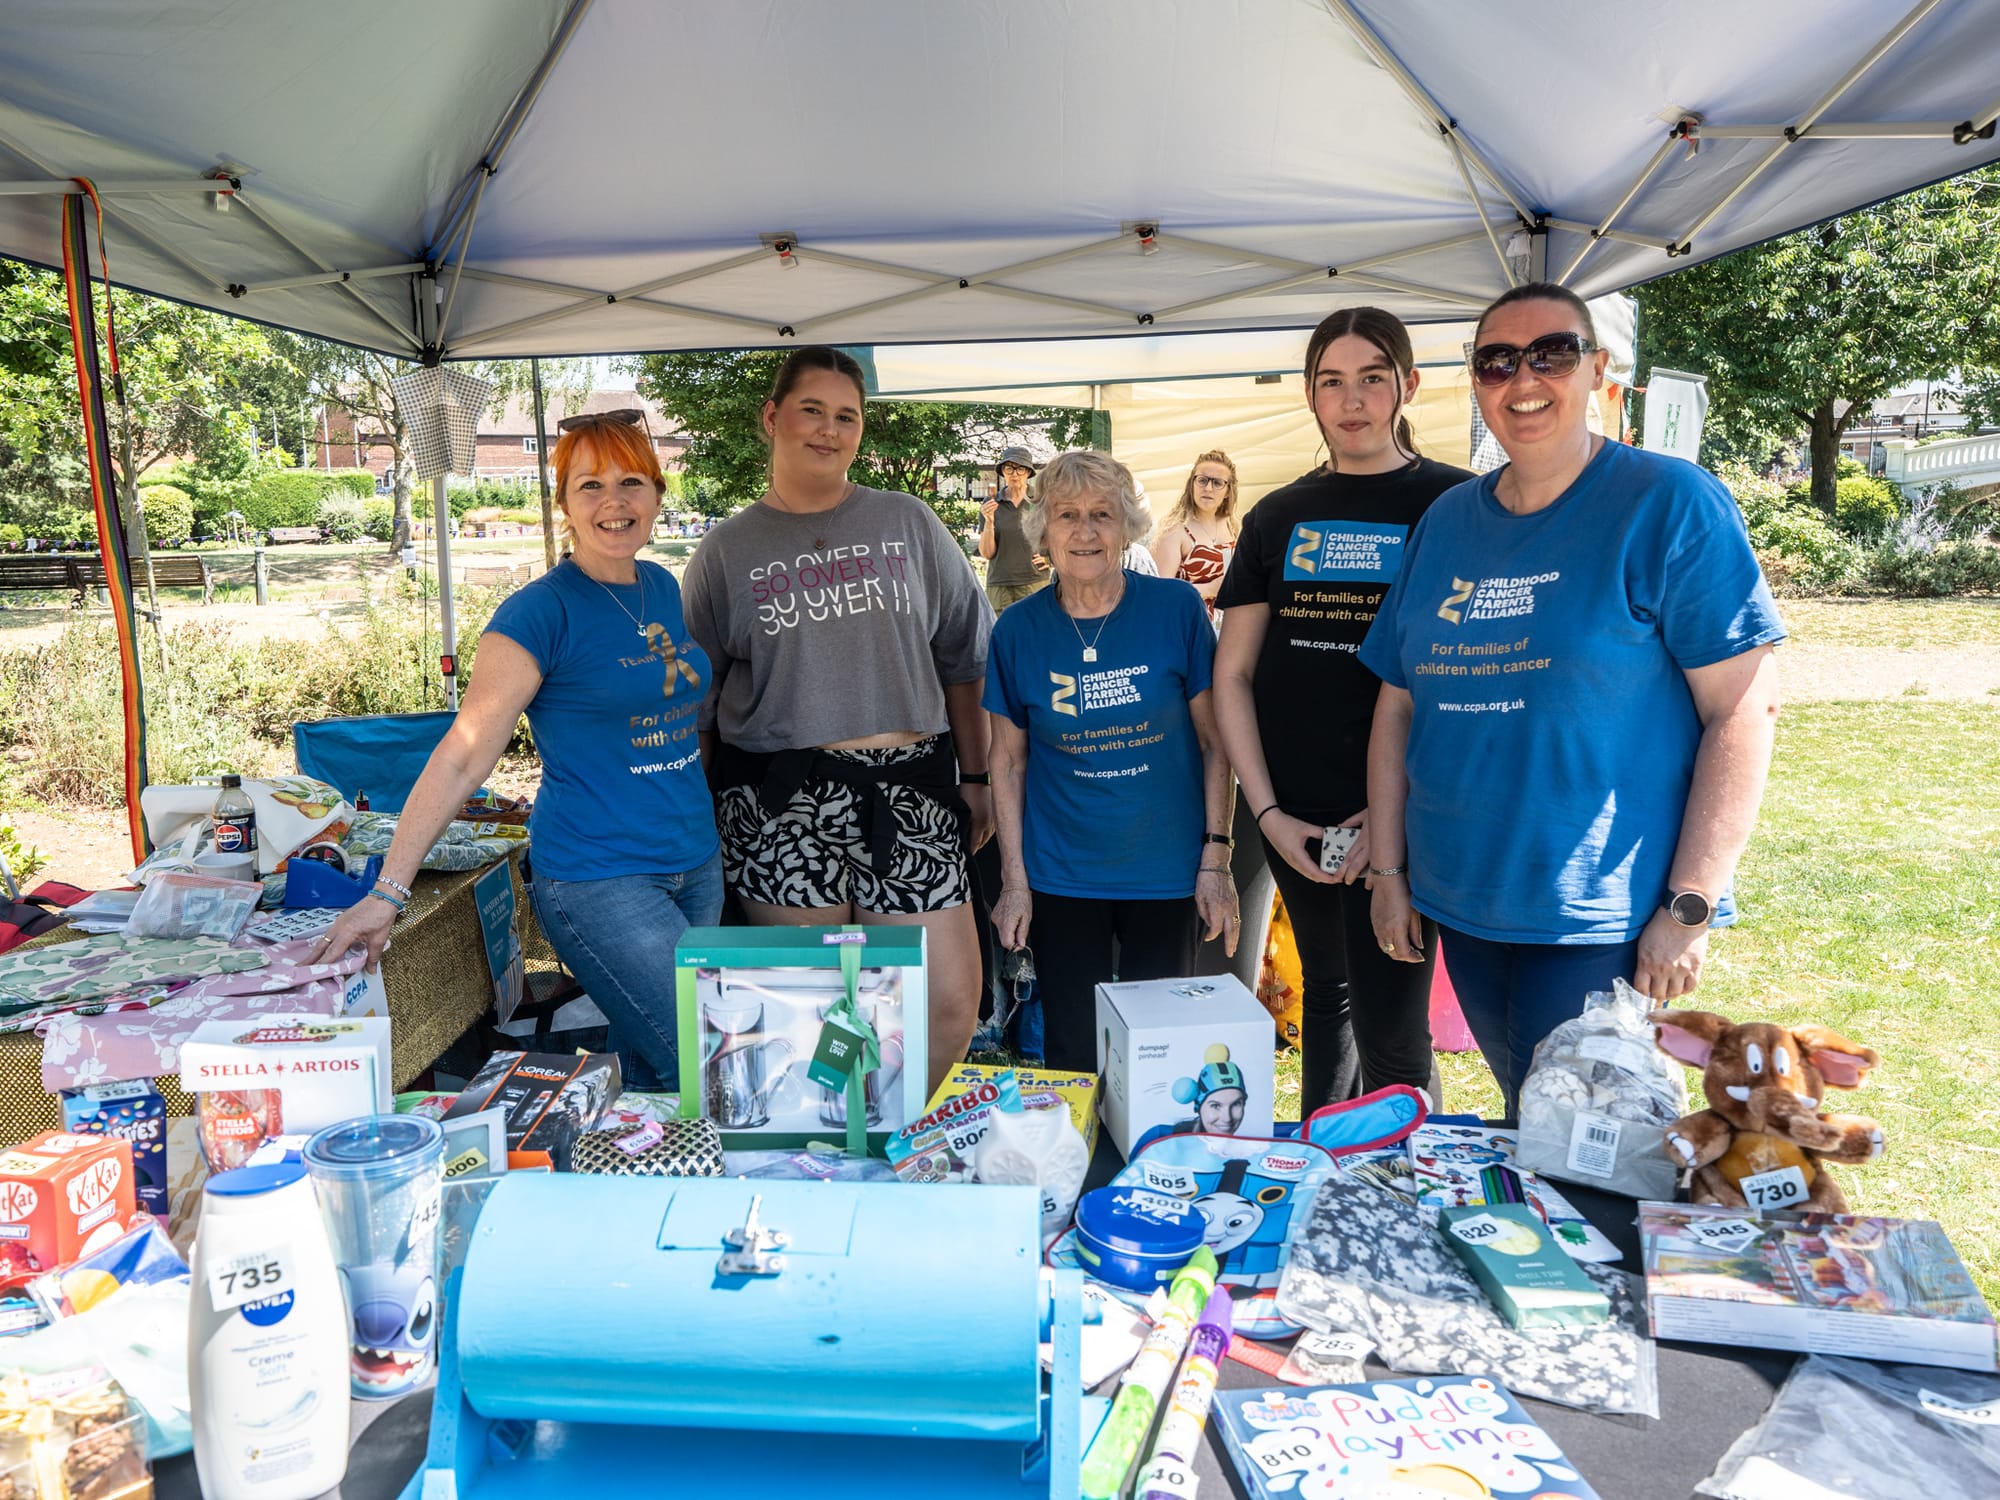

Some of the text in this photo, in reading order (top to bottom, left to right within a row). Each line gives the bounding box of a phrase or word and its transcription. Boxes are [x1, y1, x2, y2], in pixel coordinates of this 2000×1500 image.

[1327, 542, 1377, 551] CANCER
[1328, 533, 1401, 545] CHILDHOOD
[1325, 551, 1381, 561] PARENTS
[1323, 560, 1382, 570] ALLIANCE
[752, 556, 907, 603] SO OVER IT
[1480, 571, 1560, 588] CHILDHOOD
[1294, 591, 1381, 604] For families of
[1476, 586, 1532, 598] CANCER
[1473, 595, 1535, 609] PARENTS
[1279, 607, 1377, 621] children with can
[1469, 604, 1535, 619] ALLIANCE
[1432, 637, 1529, 656] For families of
[617, 654, 657, 668] TEAM
[1415, 657, 1552, 675] children with cancer
[1082, 665, 1149, 683] CHILDHOOD
[1083, 678, 1130, 692] CANCER
[1084, 685, 1136, 701] PARENTS
[1085, 693, 1141, 710] ALLIANCE
[1438, 699, 1525, 714] www.ccpa.org.uk
[629, 714, 659, 729] For
[1062, 720, 1149, 742] For families of
[631, 730, 668, 749] with
[1100, 740, 1125, 752] with
[1128, 733, 1165, 748] cancer
[1073, 763, 1150, 779] www.ccpa.org.uk
[346, 979, 368, 1004] CCPA
[829, 1047, 846, 1058] LOVE
[832, 1039, 849, 1050] WITH
[200, 1059, 360, 1077] STELLA ARTOIS
[100, 1087, 142, 1098] 395
[900, 1084, 999, 1138] HARIBO
[215, 1117, 254, 1127] STELLA
[216, 1125, 254, 1136] ARTOIS
[1266, 1157, 1307, 1167] THOMAS
[1429, 1151, 1465, 1160] 410
[76, 1161, 117, 1212] KitKat
[1149, 1174, 1187, 1189] 805
[1750, 1181, 1797, 1205] 730
[1, 1184, 33, 1220] tKat
[1041, 1197, 1057, 1215] 5
[1112, 1194, 1180, 1225] NIVEA
[1142, 1196, 1183, 1210] 400
[1459, 1223, 1497, 1240] 820
[1702, 1225, 1749, 1238] 845
[219, 1261, 282, 1295] 735
[244, 1293, 292, 1312] NIVEA
[1314, 1336, 1357, 1352] 785
[248, 1350, 294, 1368] Creme
[258, 1364, 287, 1378] Soft
[1332, 1391, 1493, 1426] Puddle
[1262, 1445, 1312, 1467] 810
[1149, 1468, 1185, 1486] 40
